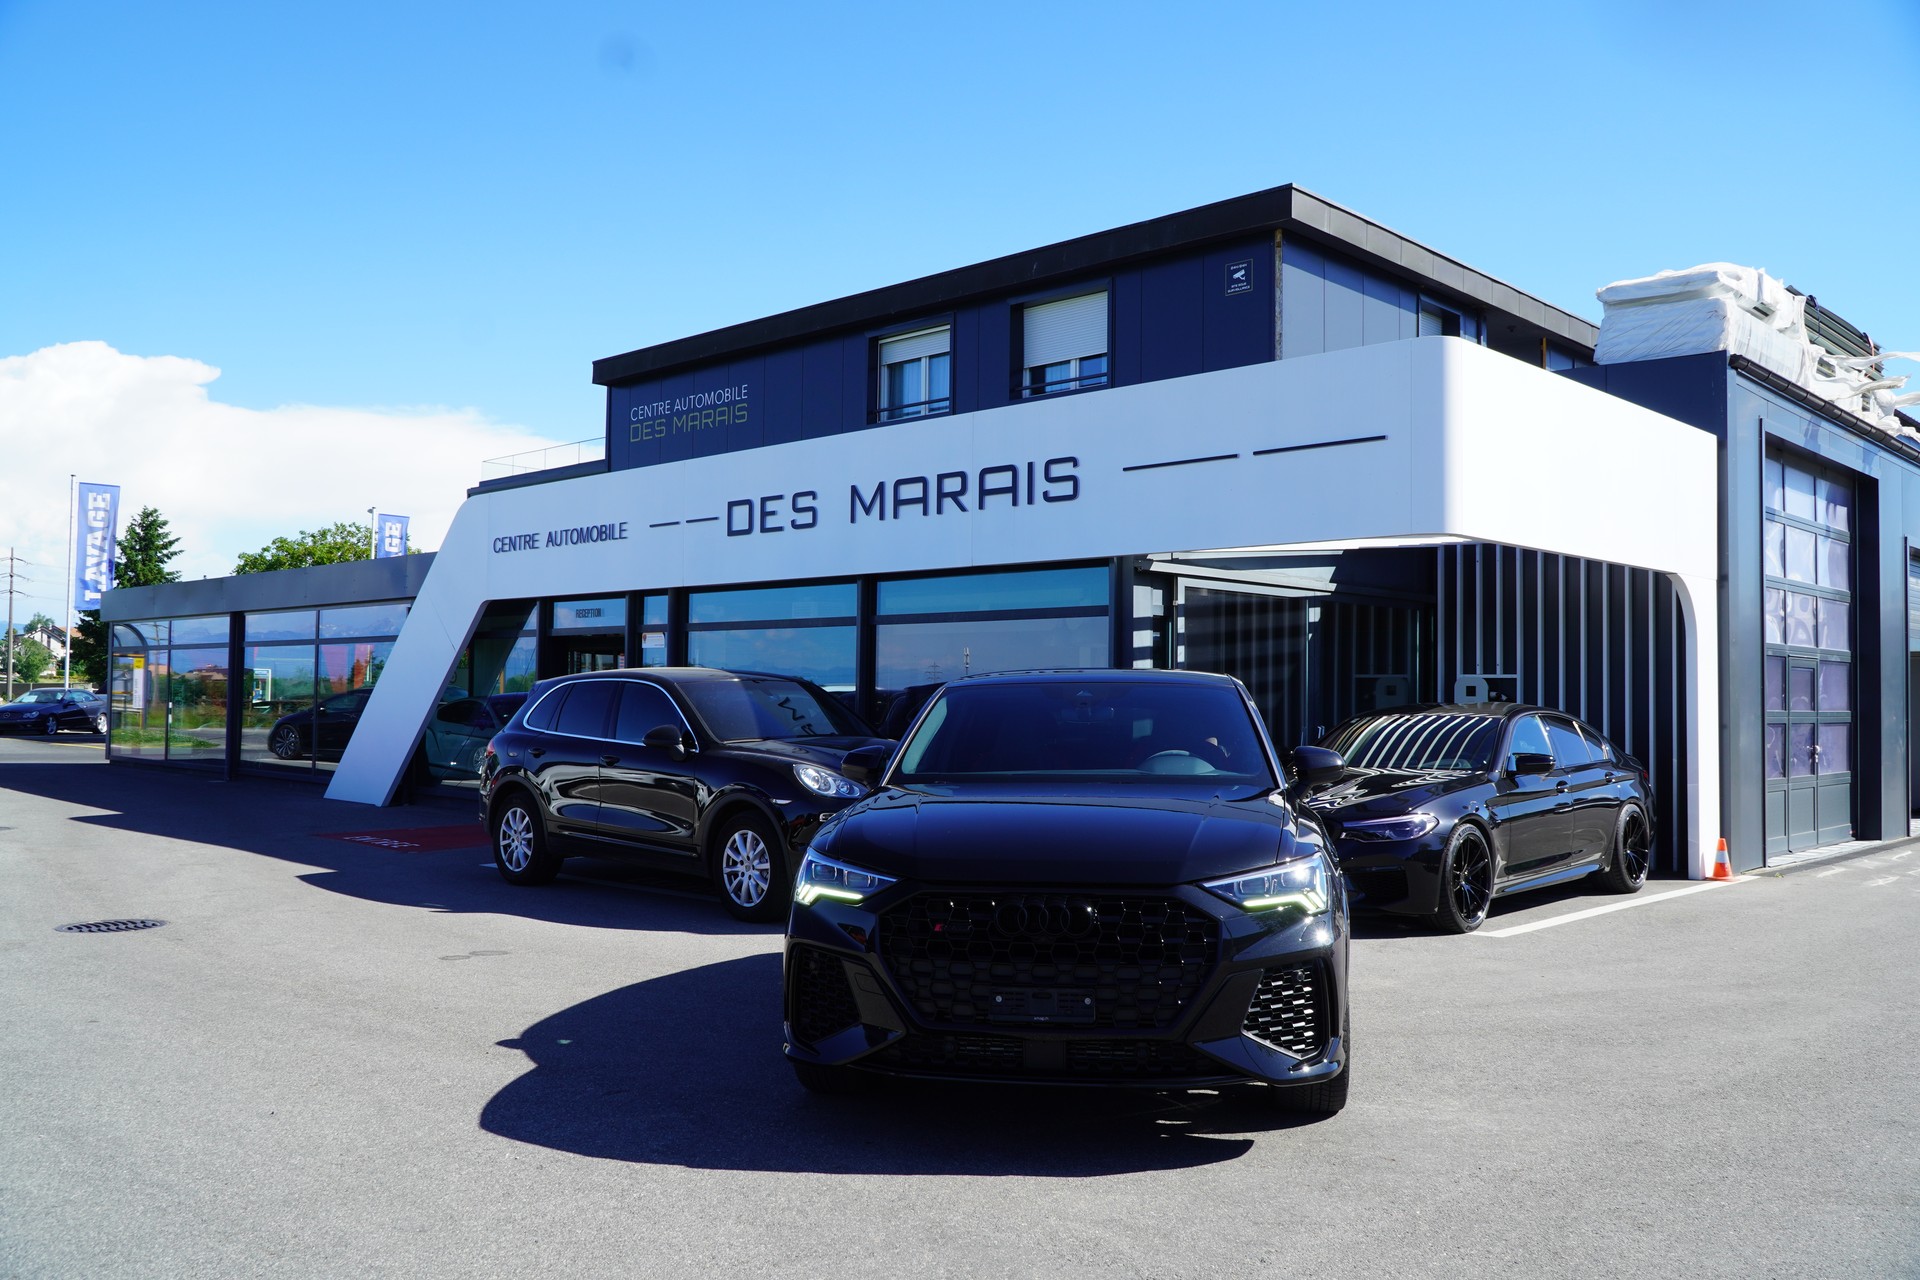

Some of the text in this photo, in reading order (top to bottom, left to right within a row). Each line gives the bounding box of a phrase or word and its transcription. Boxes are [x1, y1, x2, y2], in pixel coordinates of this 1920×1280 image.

[630, 384, 748, 421] CENTRE AUTOMOBILE
[630, 403, 748, 442] DES MARAIS
[493, 456, 1080, 554] CENTRE AUTOMOBILE DES MARAIS
[575, 607, 602, 619] RECEPTION
